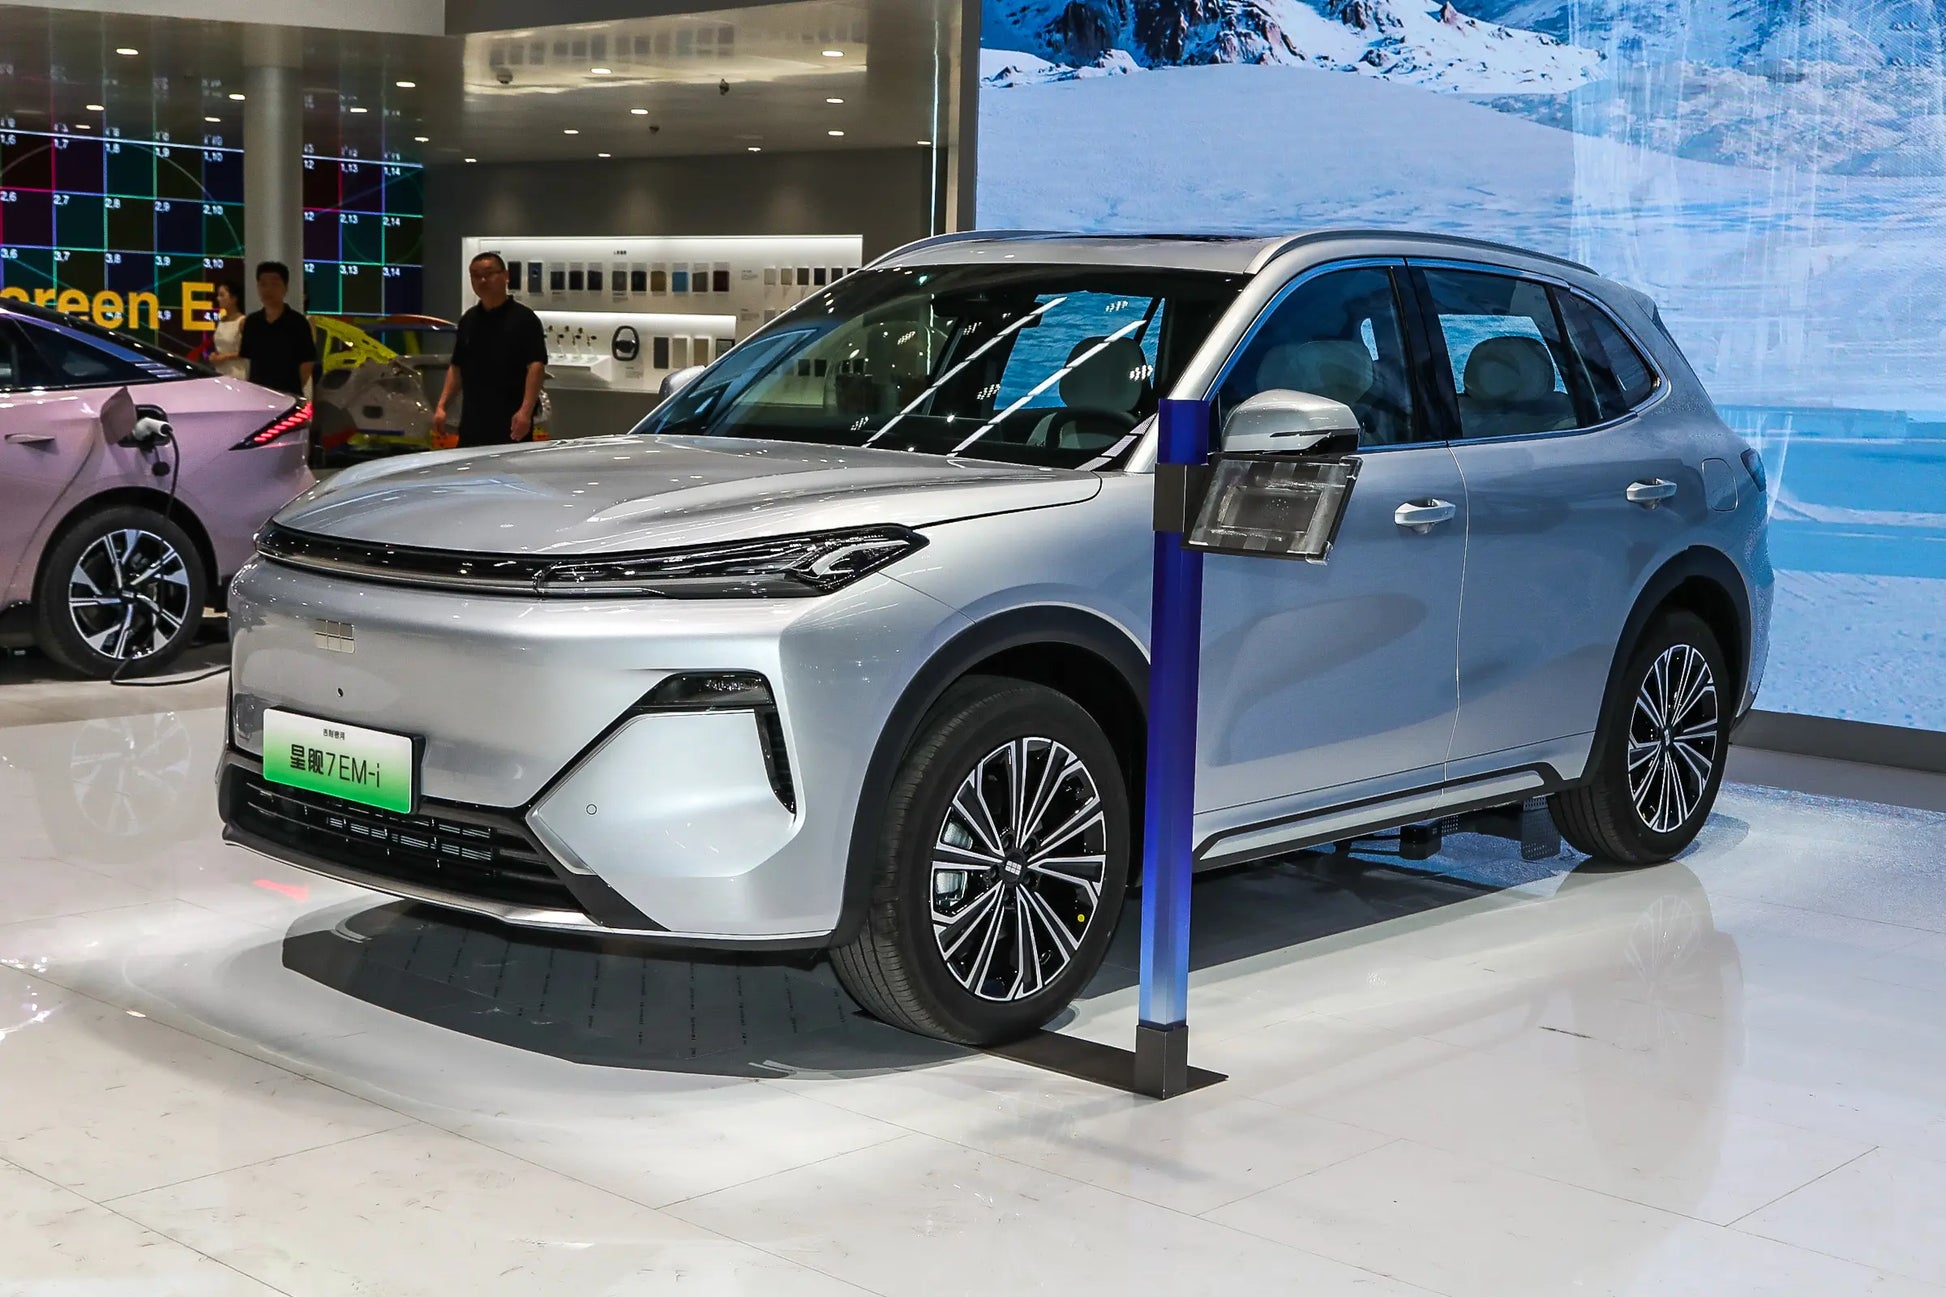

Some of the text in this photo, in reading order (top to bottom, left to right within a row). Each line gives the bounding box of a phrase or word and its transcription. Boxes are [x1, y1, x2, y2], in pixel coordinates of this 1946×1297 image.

[53, 194, 70, 205] 2,7
[340, 214, 358, 224] 2,13
[383, 216, 400, 227] 2,14
[53, 251, 71, 262] 3,7
[339, 265, 358, 275] 3,13
[383, 267, 400, 277] 3,14
